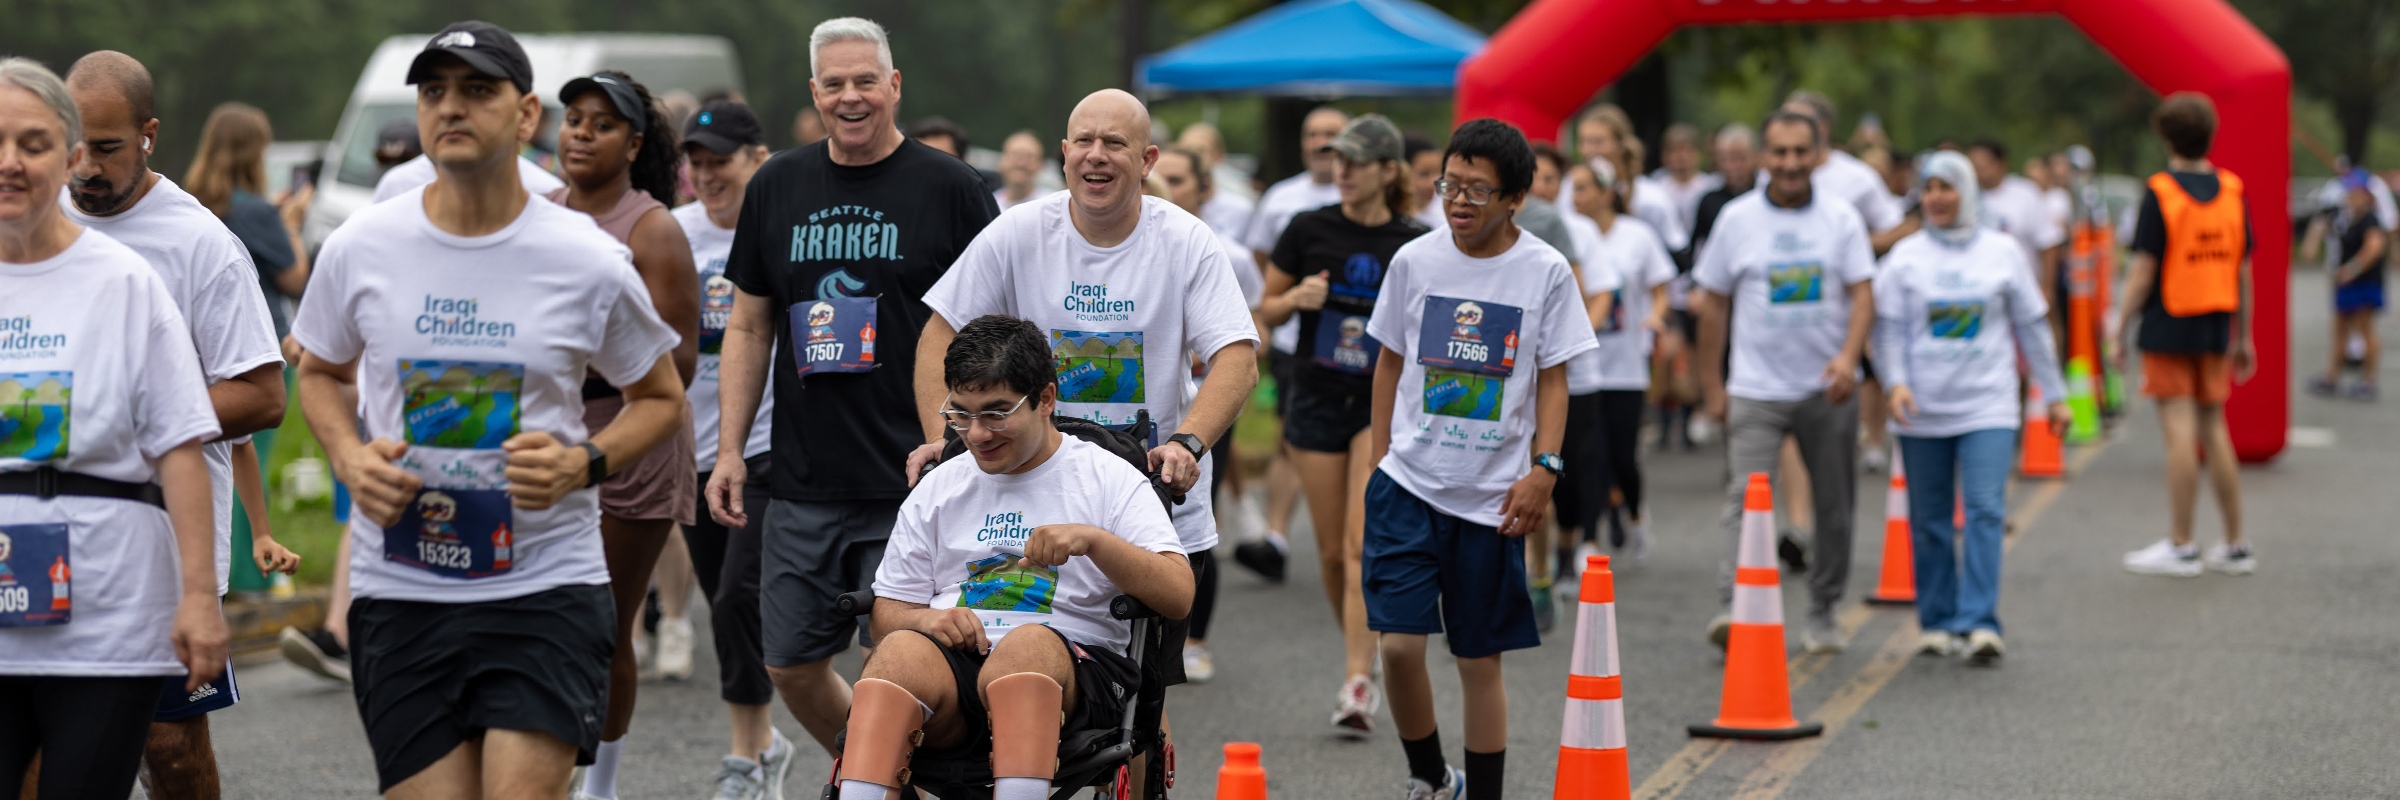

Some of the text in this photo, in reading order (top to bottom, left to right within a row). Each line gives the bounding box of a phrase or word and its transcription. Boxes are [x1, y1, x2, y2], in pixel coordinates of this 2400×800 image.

[808, 205, 884, 224] SEATTLE
[790, 222, 899, 263] KRAKEN
[1071, 281, 1108, 299] Iraqi
[425, 294, 478, 317] Iraqi
[1064, 295, 1135, 313] Children
[415, 314, 516, 338] Children
[1075, 313, 1129, 322] FOUNDATION
[805, 343, 844, 363] 17507
[1447, 341, 1488, 363] 17566
[984, 510, 1023, 528] Iraqi
[416, 541, 472, 569] 15323
